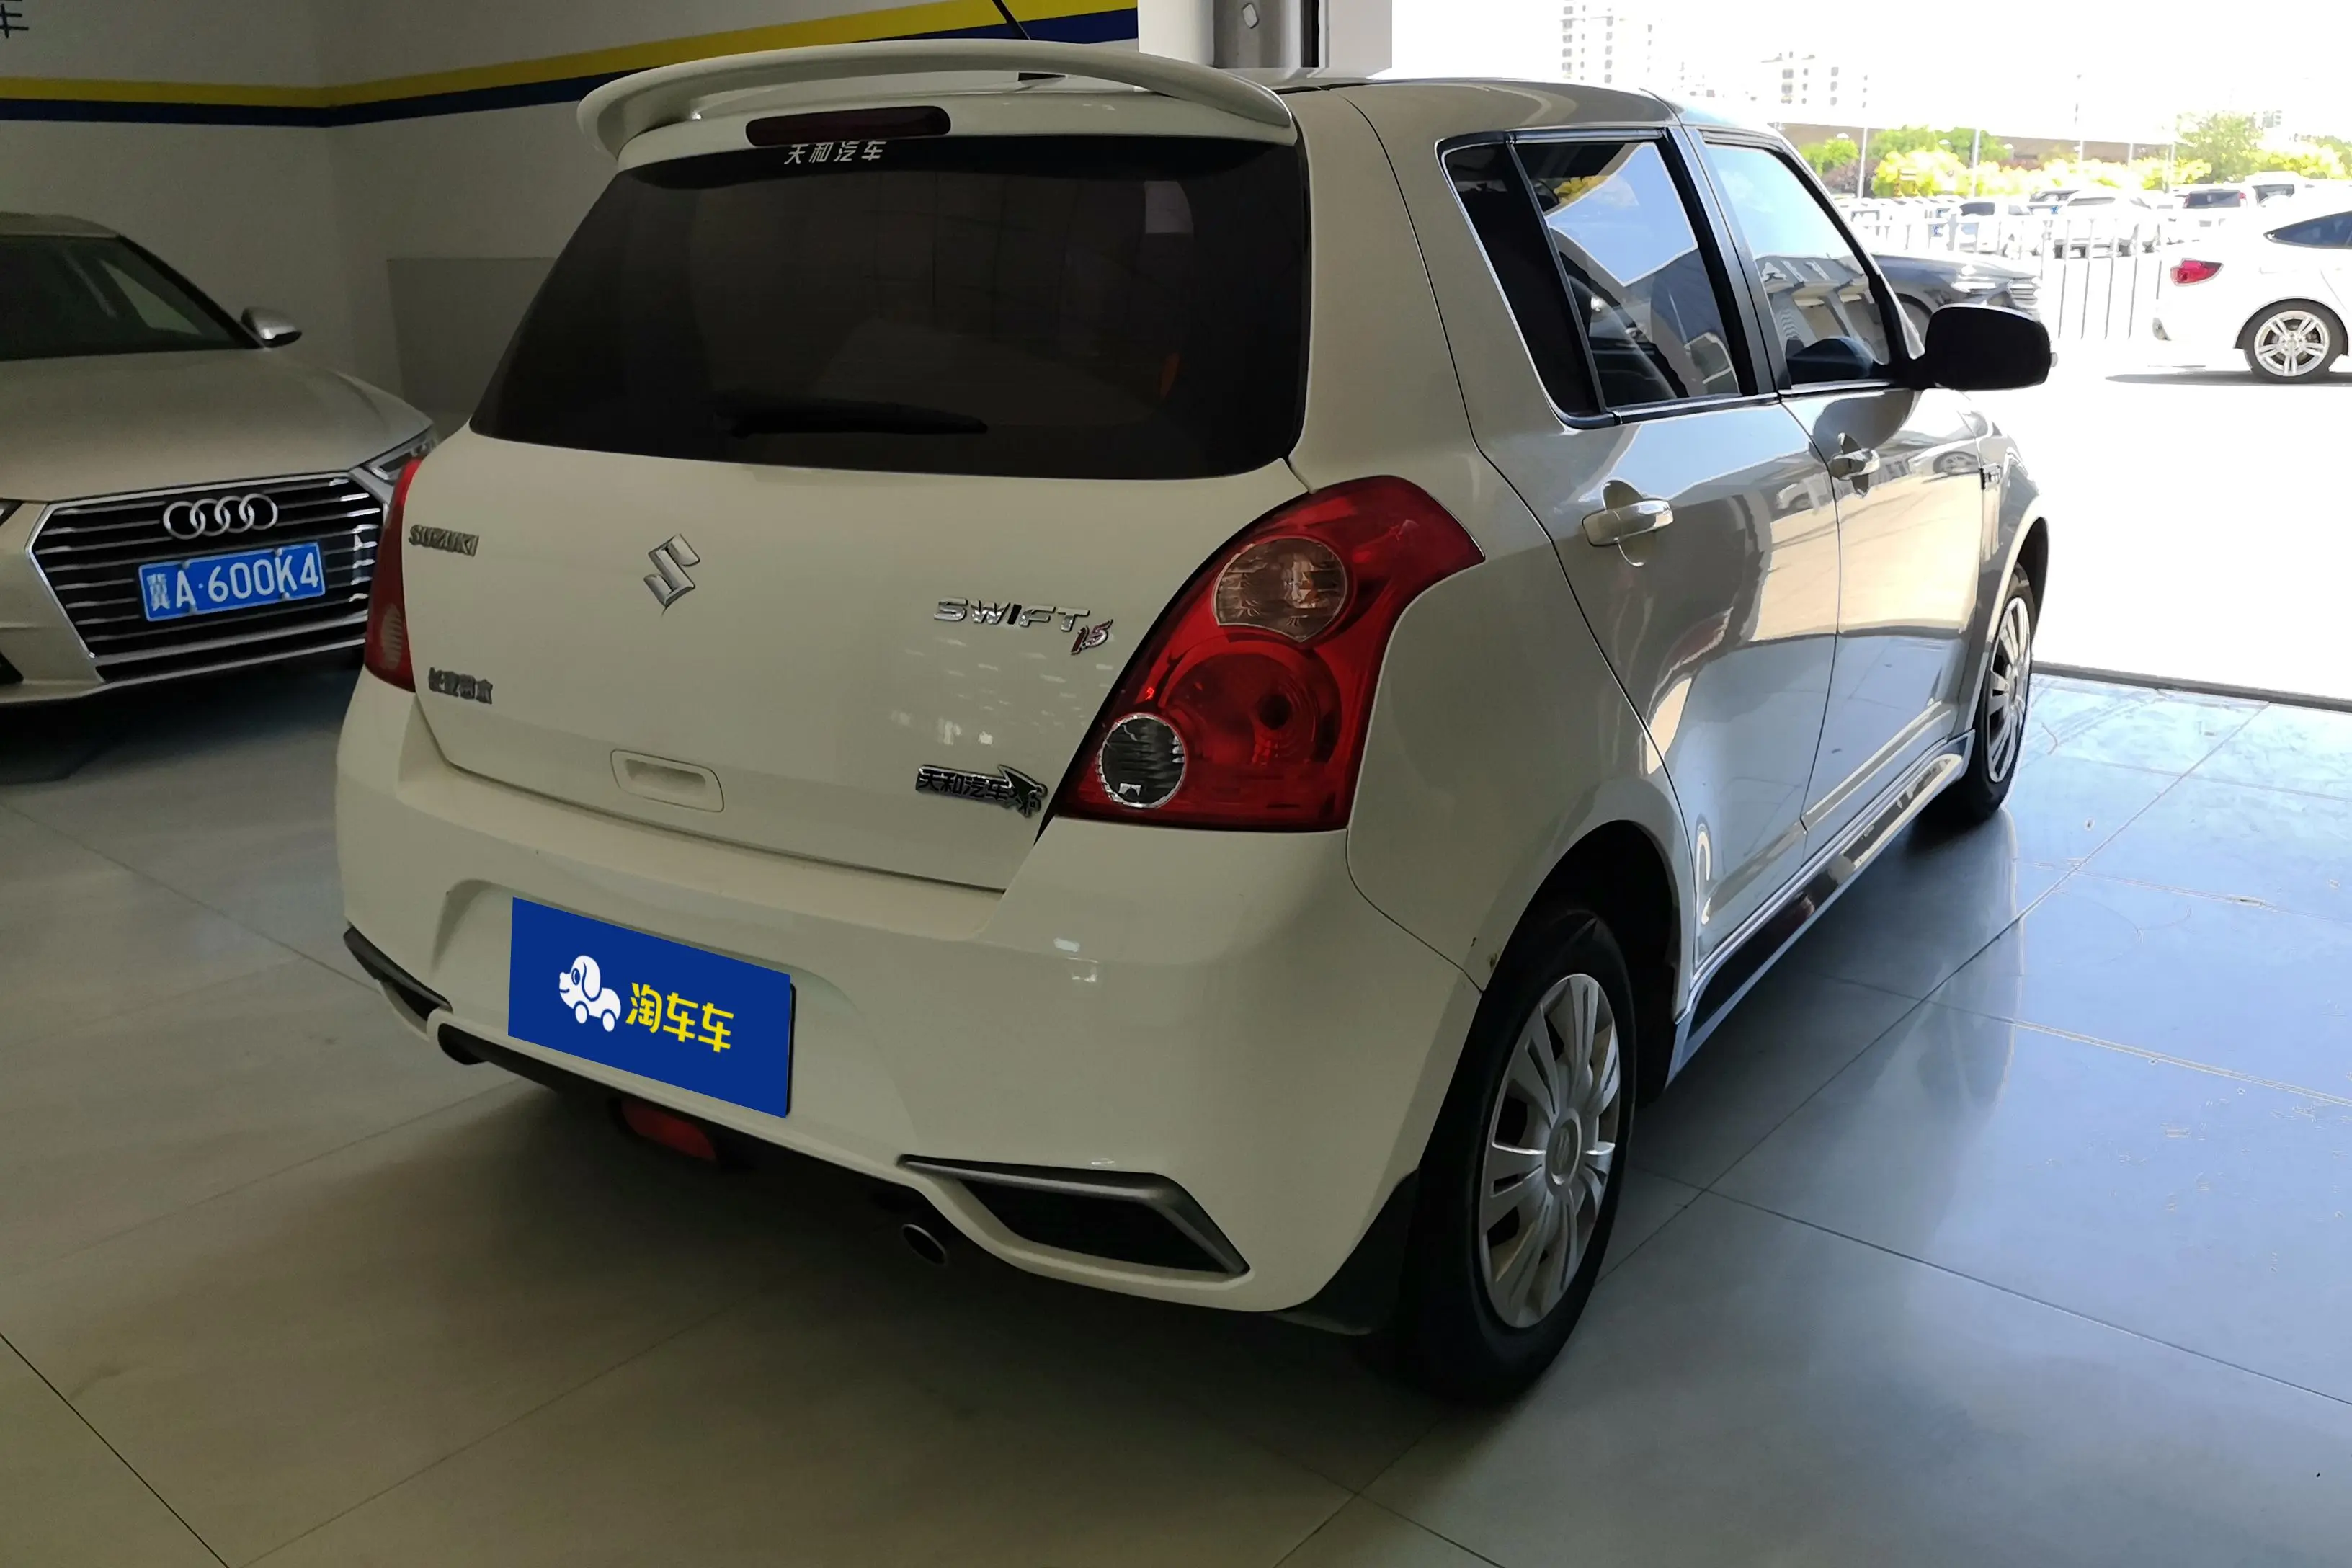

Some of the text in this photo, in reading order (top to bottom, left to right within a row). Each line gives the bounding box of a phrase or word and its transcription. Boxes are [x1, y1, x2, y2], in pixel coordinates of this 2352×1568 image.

[783, 140, 887, 164] 天和汽车
[408, 525, 479, 557] SUZUKI
[934, 598, 1090, 633] SWIFT
[917, 768, 1010, 801] 天和汽车
